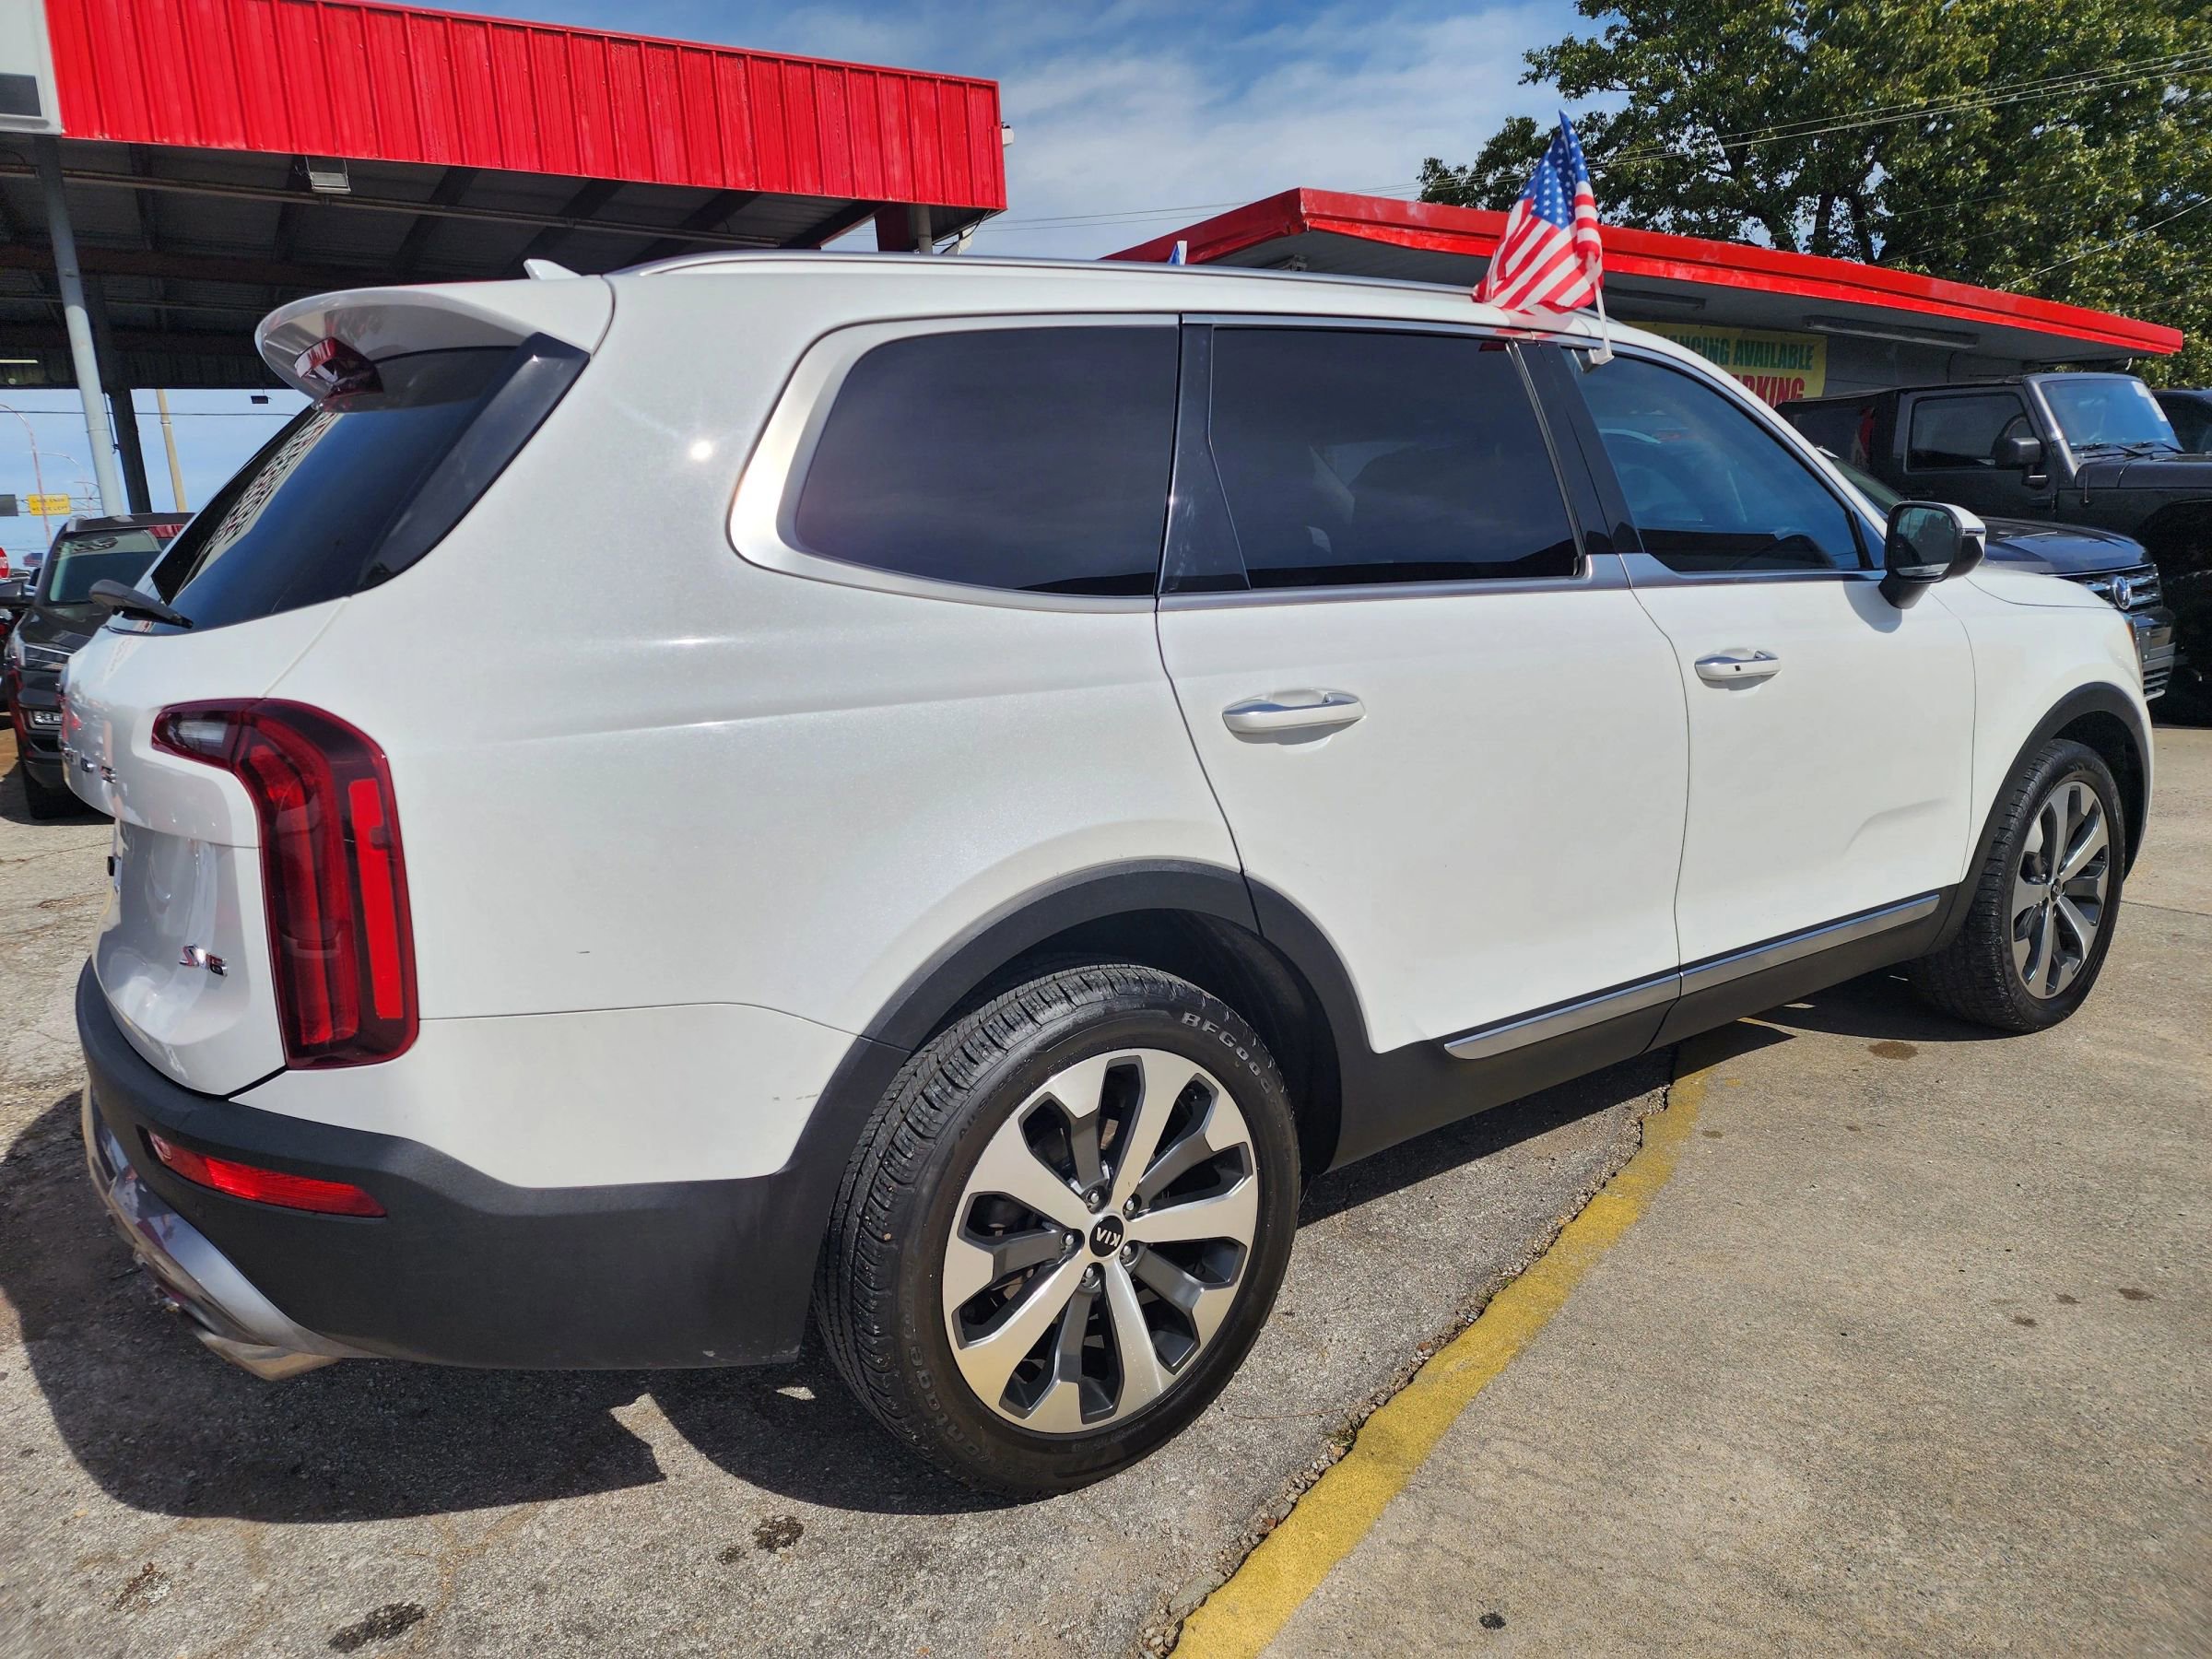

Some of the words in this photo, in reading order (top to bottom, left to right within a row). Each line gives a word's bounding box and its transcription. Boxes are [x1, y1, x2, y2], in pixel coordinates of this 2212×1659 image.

[1733, 339, 1814, 371] AVAILABLE
[1731, 374, 1806, 407] RKING
[1096, 1227, 1122, 1247] KIA
